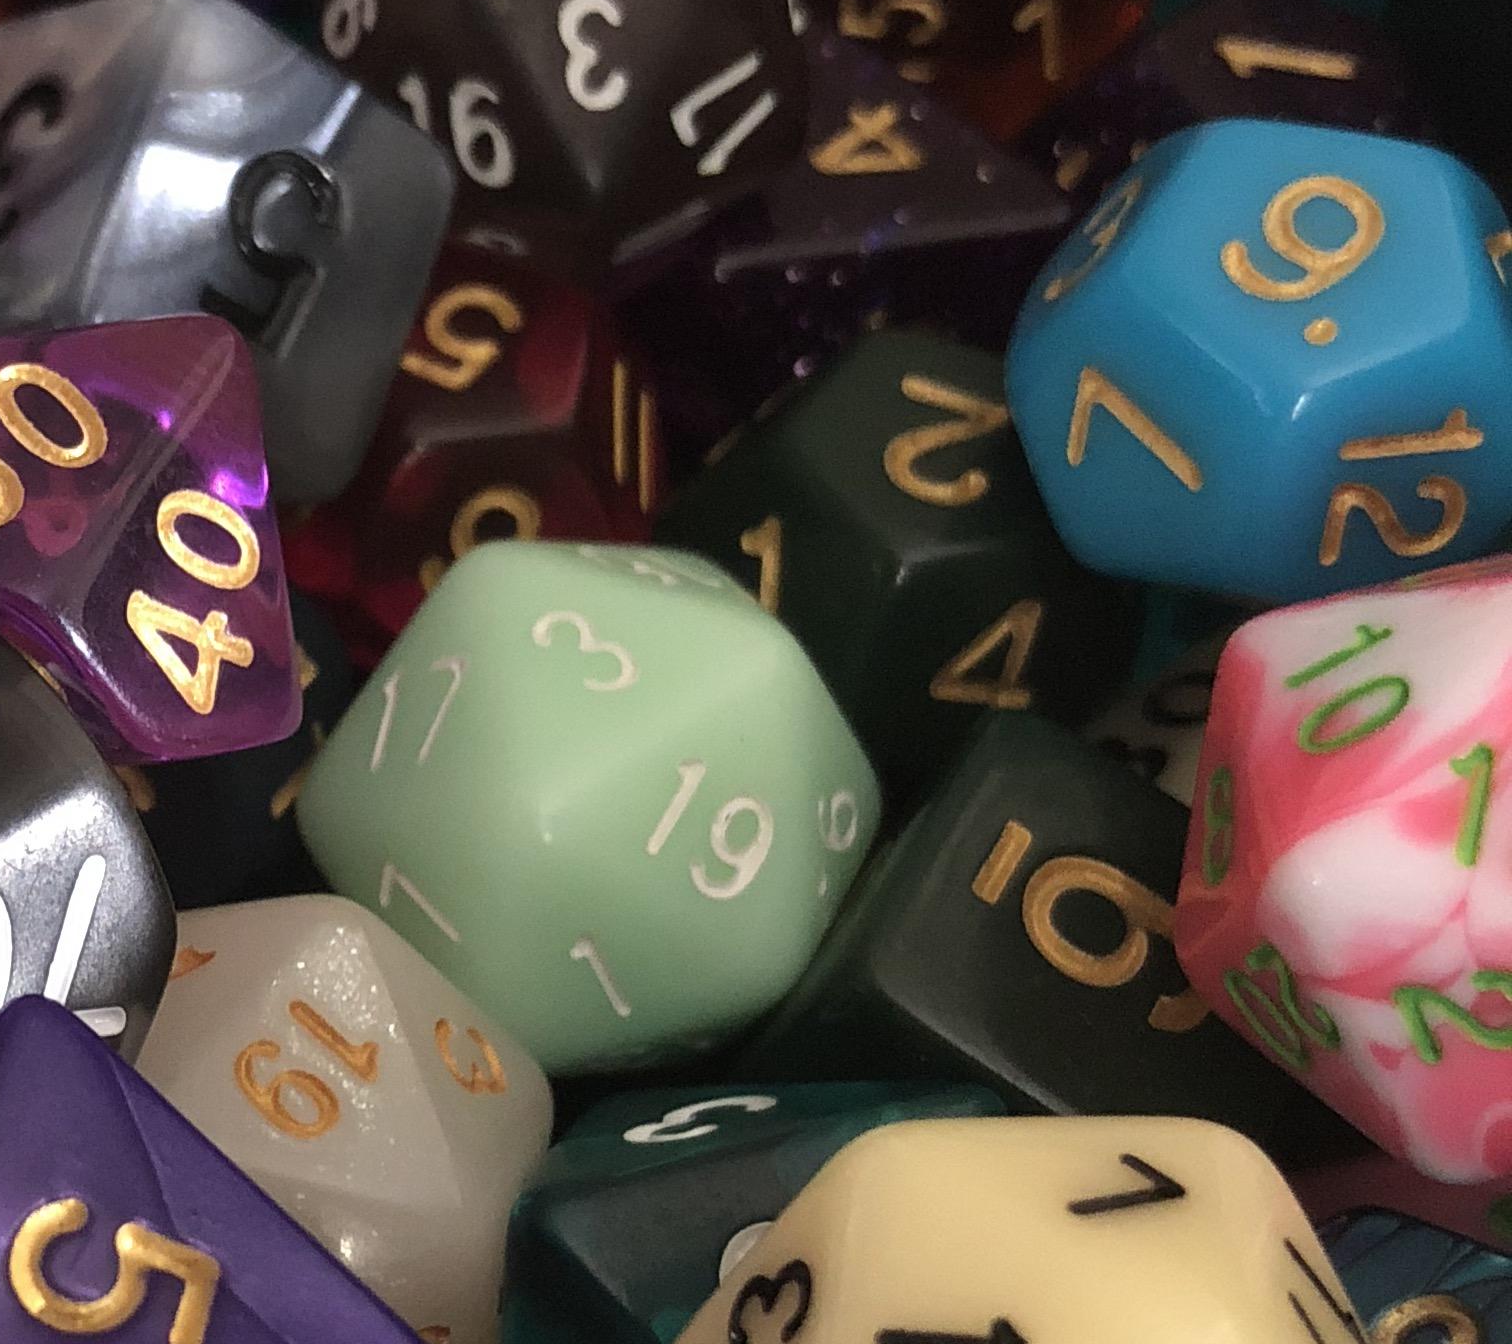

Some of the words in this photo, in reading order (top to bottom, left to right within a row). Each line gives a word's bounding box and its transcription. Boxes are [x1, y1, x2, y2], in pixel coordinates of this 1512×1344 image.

[1213, 36, 1358, 81] 1
[808, 101, 923, 176] 4
[198, 149, 348, 356] 5
[401, 283, 521, 391] 5
[883, 371, 1010, 507] 2
[1066, 366, 1204, 492] 7
[1318, 406, 1486, 567] 12
[125, 489, 260, 716] 40
[531, 611, 638, 691] 3
[928, 598, 1043, 711] 4
[1286, 622, 1411, 756] 10
[643, 761, 776, 901] 19
[233, 1000, 378, 1139] 19
[434, 1016, 507, 1095] 3
[623, 1095, 778, 1144] 3
